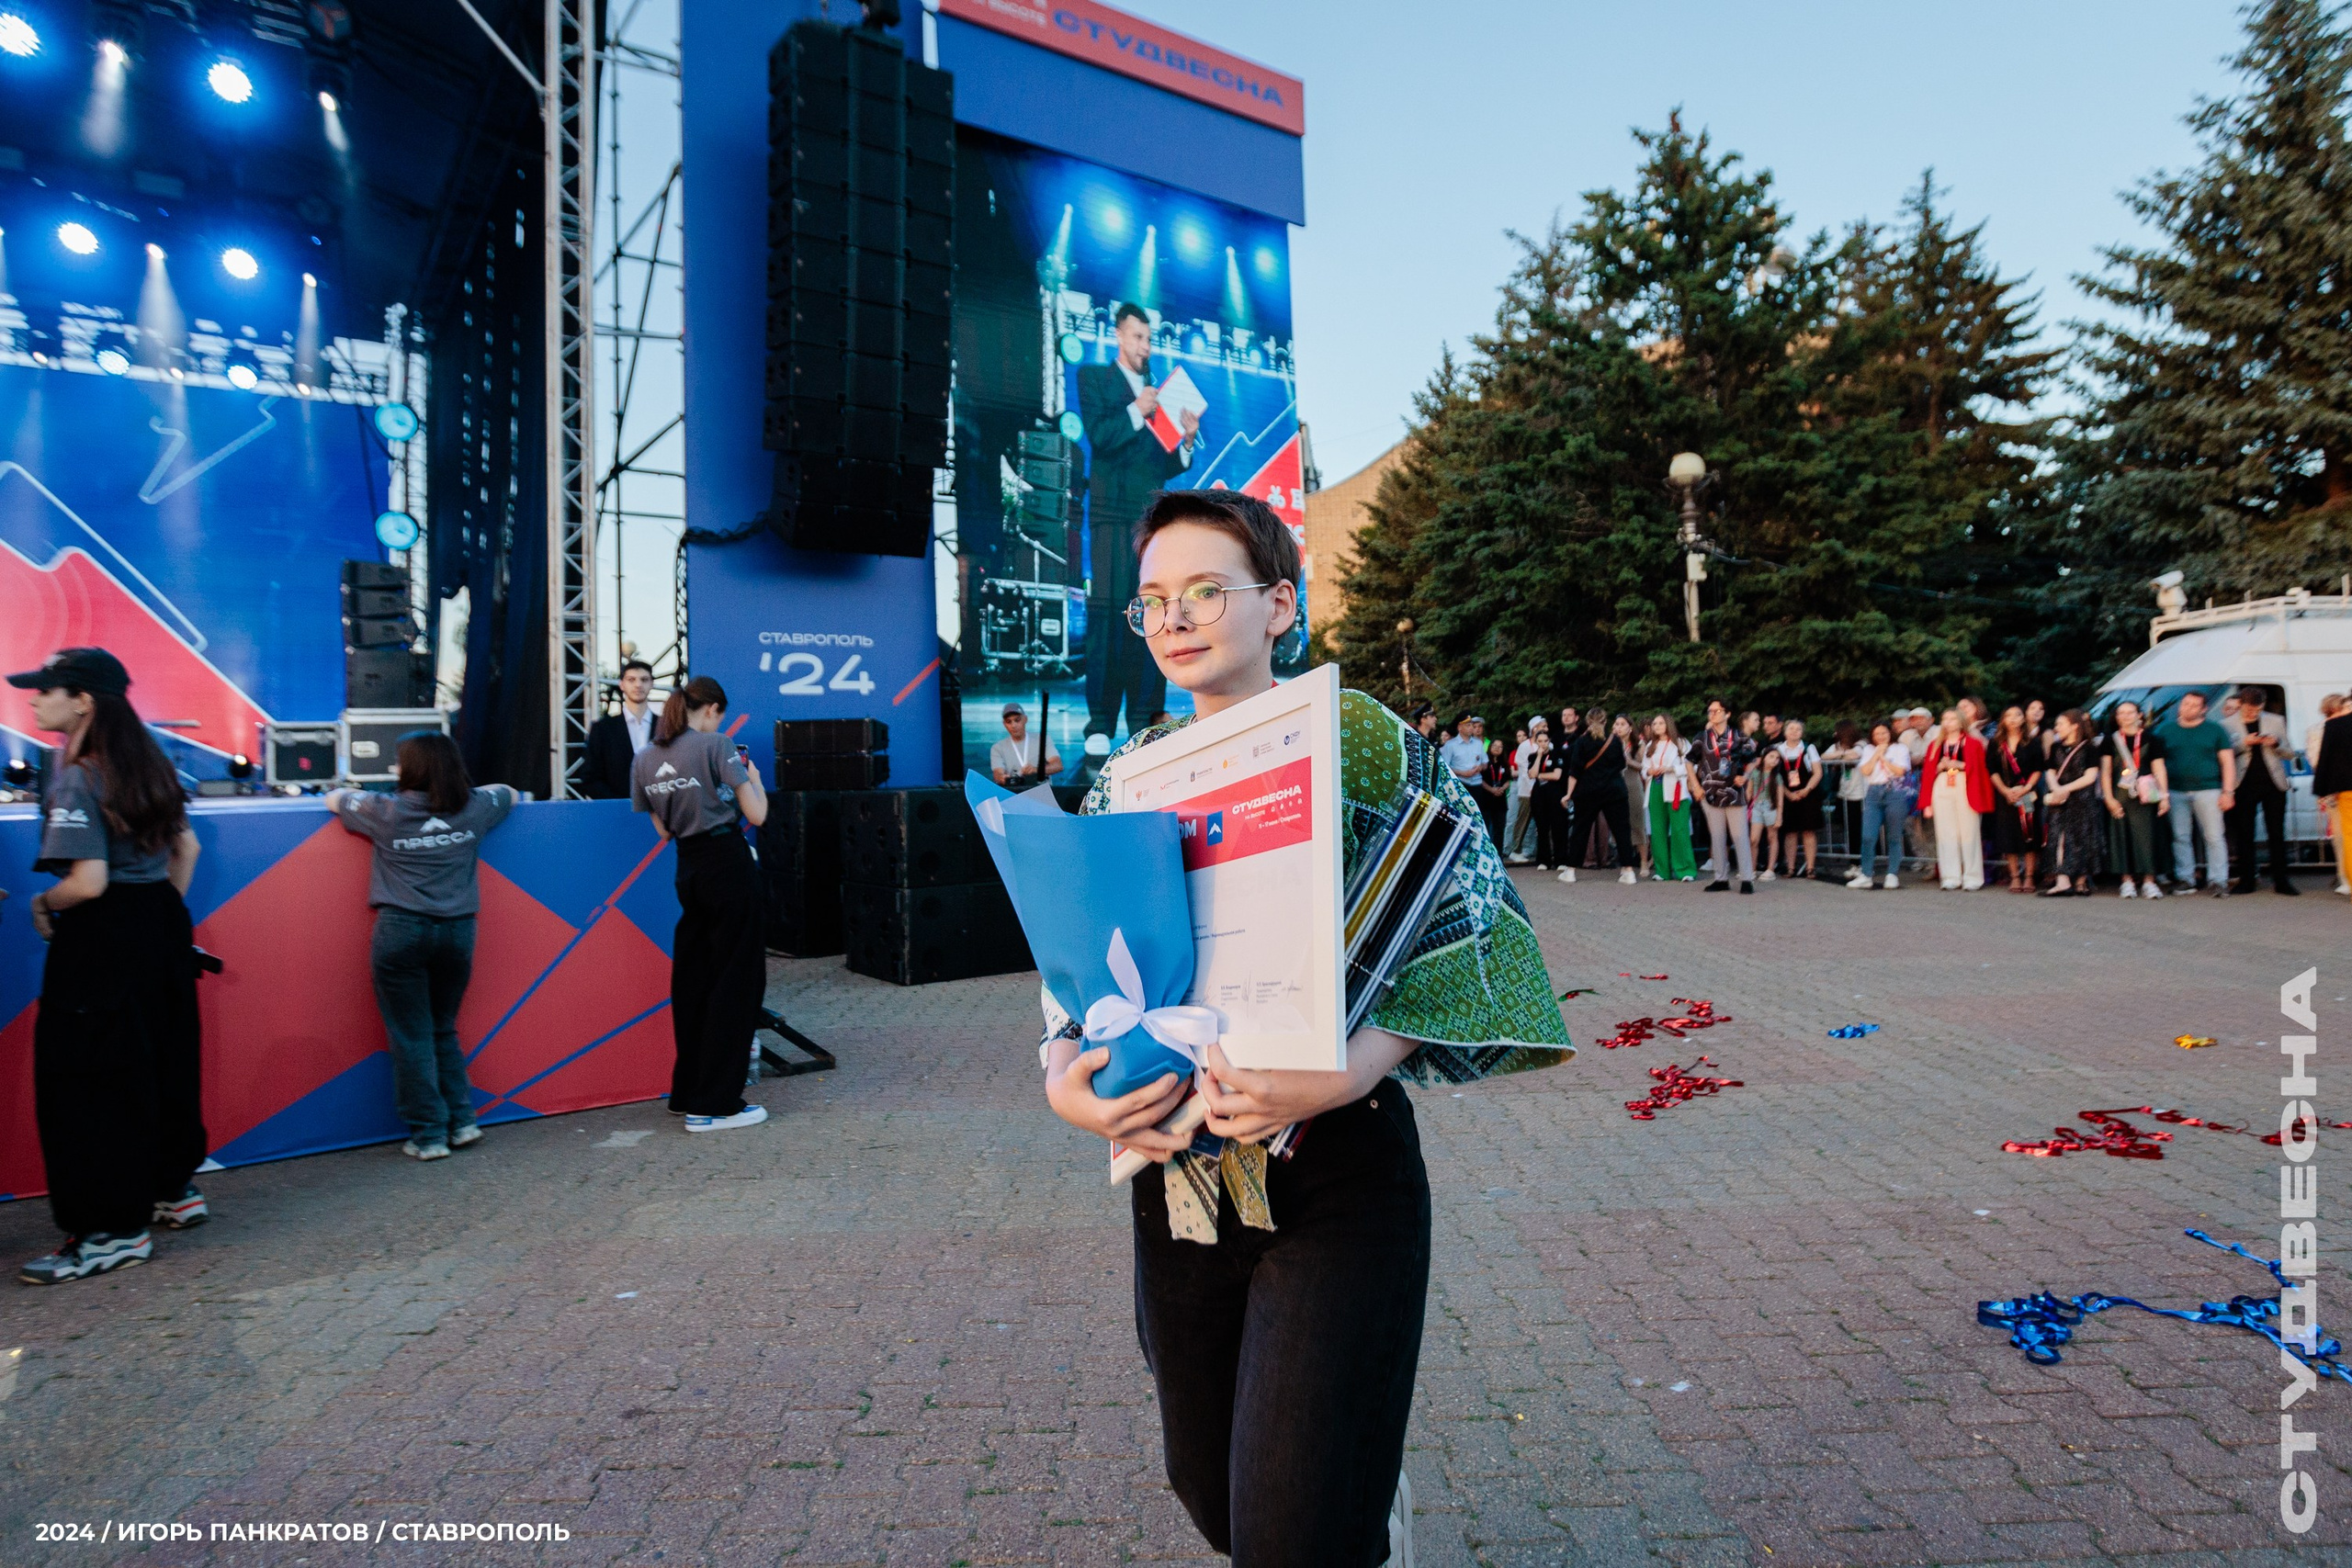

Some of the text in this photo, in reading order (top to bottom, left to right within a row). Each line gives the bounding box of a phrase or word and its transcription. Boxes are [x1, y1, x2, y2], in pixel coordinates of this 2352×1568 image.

[1052, 8, 1284, 108] СТУДВЕСНА
[758, 631, 874, 648] СТАВРОПОЛЬ
[644, 776, 702, 797] ПРЕССА
[1232, 784, 1302, 815] СТУДВЕСНА
[392, 829, 476, 851] ПРЕССА
